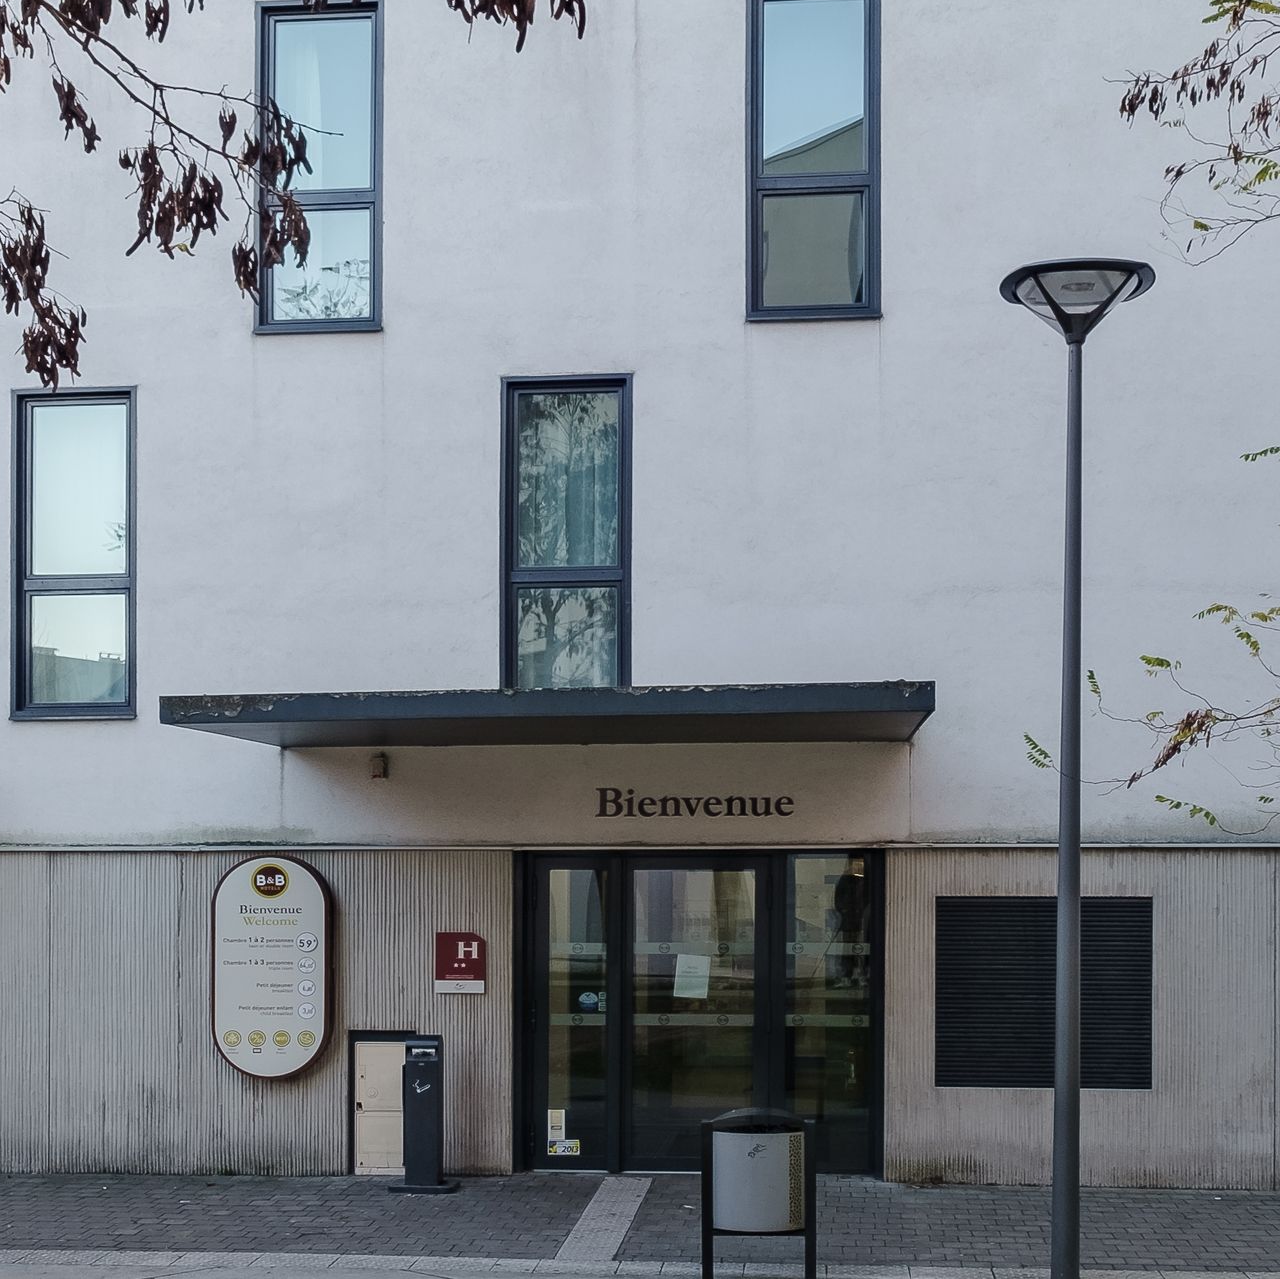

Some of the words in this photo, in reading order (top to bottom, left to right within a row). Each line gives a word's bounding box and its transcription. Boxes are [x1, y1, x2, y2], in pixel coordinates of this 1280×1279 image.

[595, 787, 795, 818] Bienvenue
[256, 874, 285, 886] B&B
[239, 904, 302, 914] Bienvenue
[243, 917, 299, 926] Welcome
[456, 941, 479, 959] H
